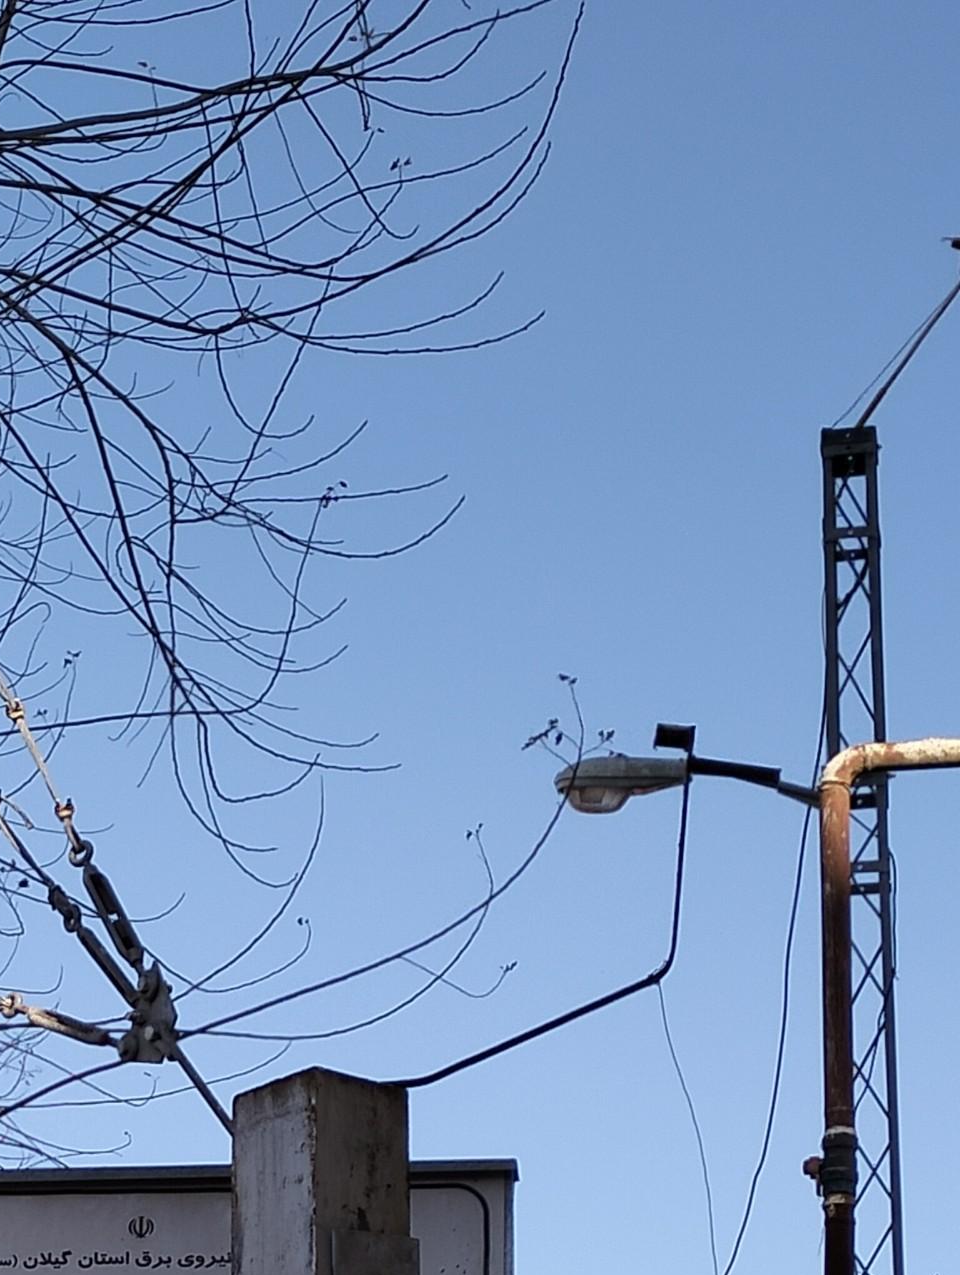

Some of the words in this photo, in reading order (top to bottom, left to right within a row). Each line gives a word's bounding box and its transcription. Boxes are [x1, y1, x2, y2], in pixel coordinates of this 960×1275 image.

[22, 1250, 72, 1270] گیلان
[78, 1251, 131, 1269] استان
[135, 1250, 172, 1269] برق
